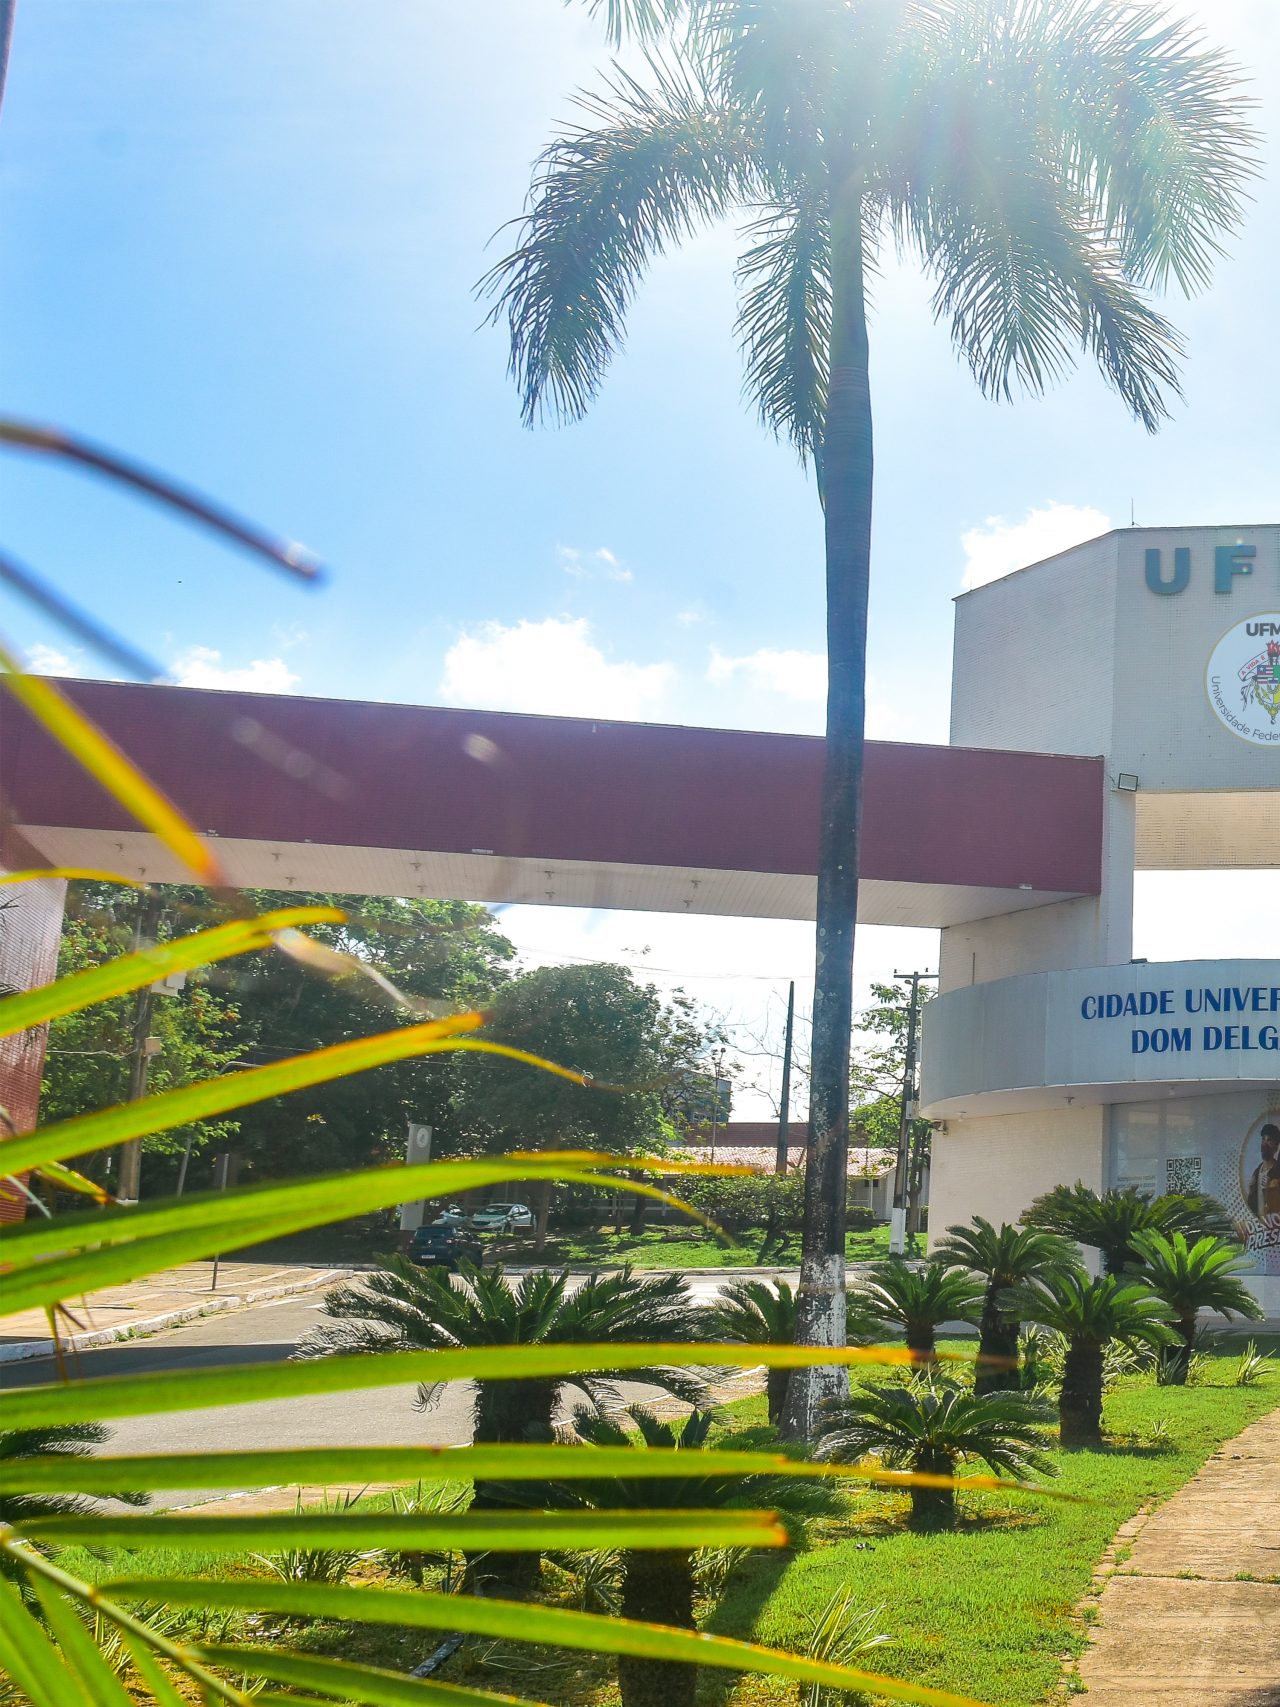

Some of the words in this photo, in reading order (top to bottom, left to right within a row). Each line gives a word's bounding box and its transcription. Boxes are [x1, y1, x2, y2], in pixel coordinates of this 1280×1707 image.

[1246, 659, 1259, 670] VIDA
[1211, 675, 1251, 735] Universidade
[1081, 990, 1175, 1020] CIDADE
[1131, 1027, 1191, 1053] DOM
